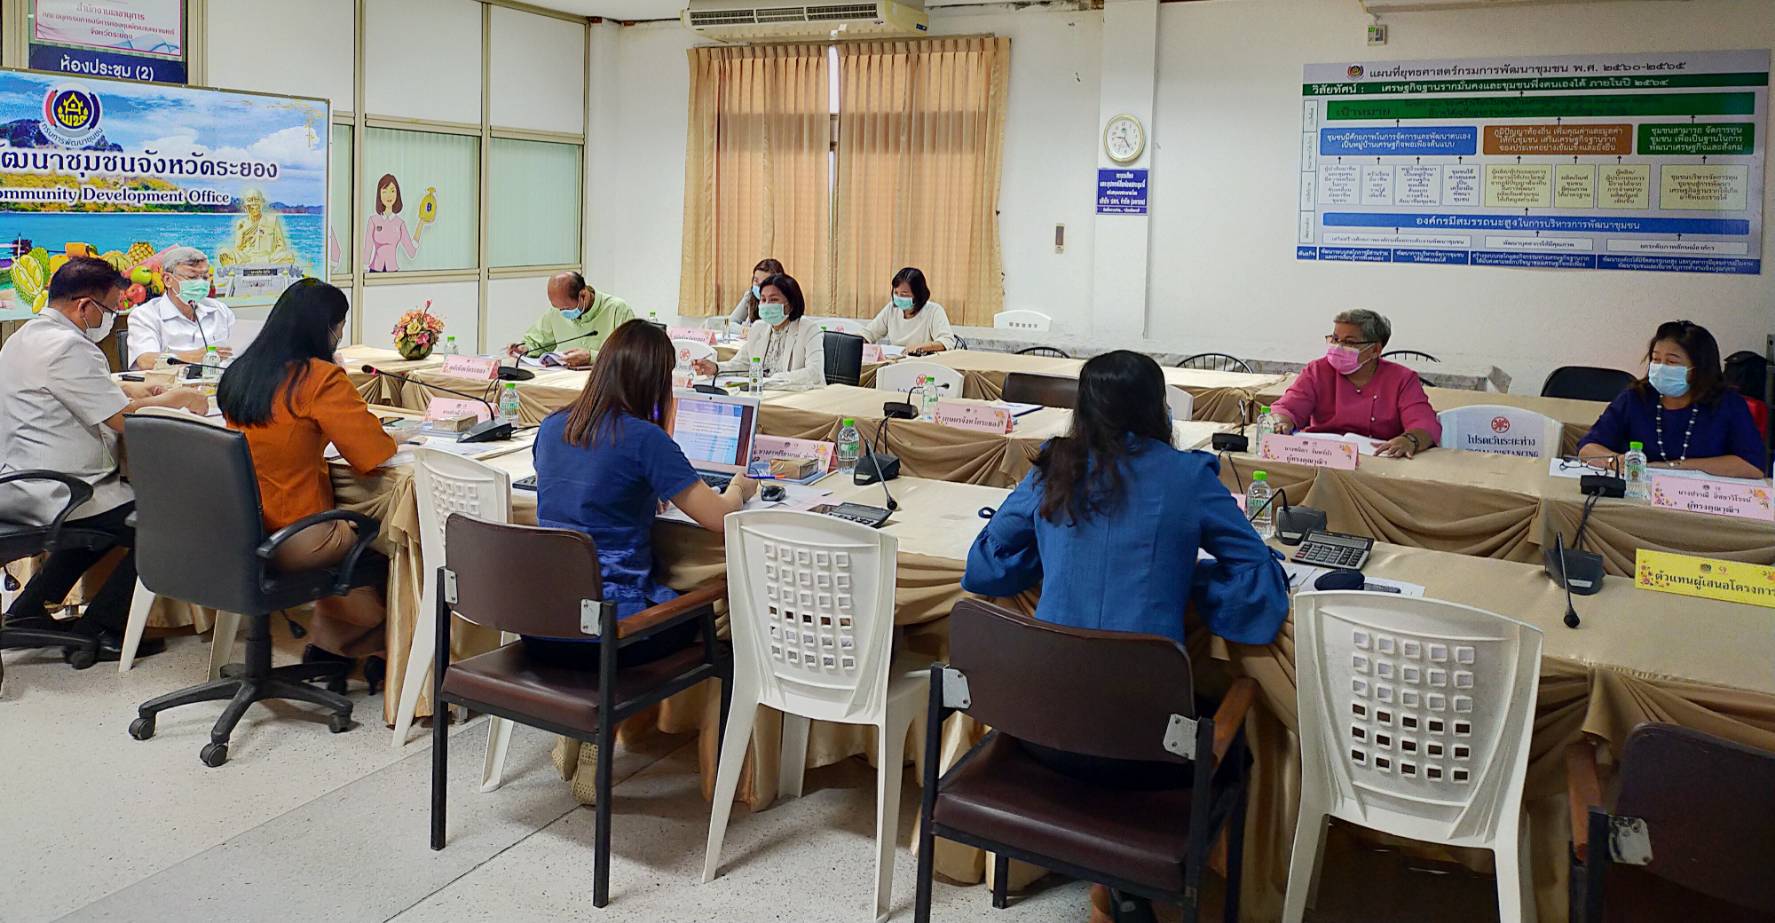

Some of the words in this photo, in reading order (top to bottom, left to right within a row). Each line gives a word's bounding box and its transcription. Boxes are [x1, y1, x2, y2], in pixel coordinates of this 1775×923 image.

[60, 54, 131, 79] ห้องประชุม
[135, 65, 154, 81] (2)
[1573, 63, 1598, 73] พ.ศ.
[1312, 82, 1357, 94] วิสัยทัศน์
[83, 186, 184, 204] Development
[188, 188, 230, 204] Office
